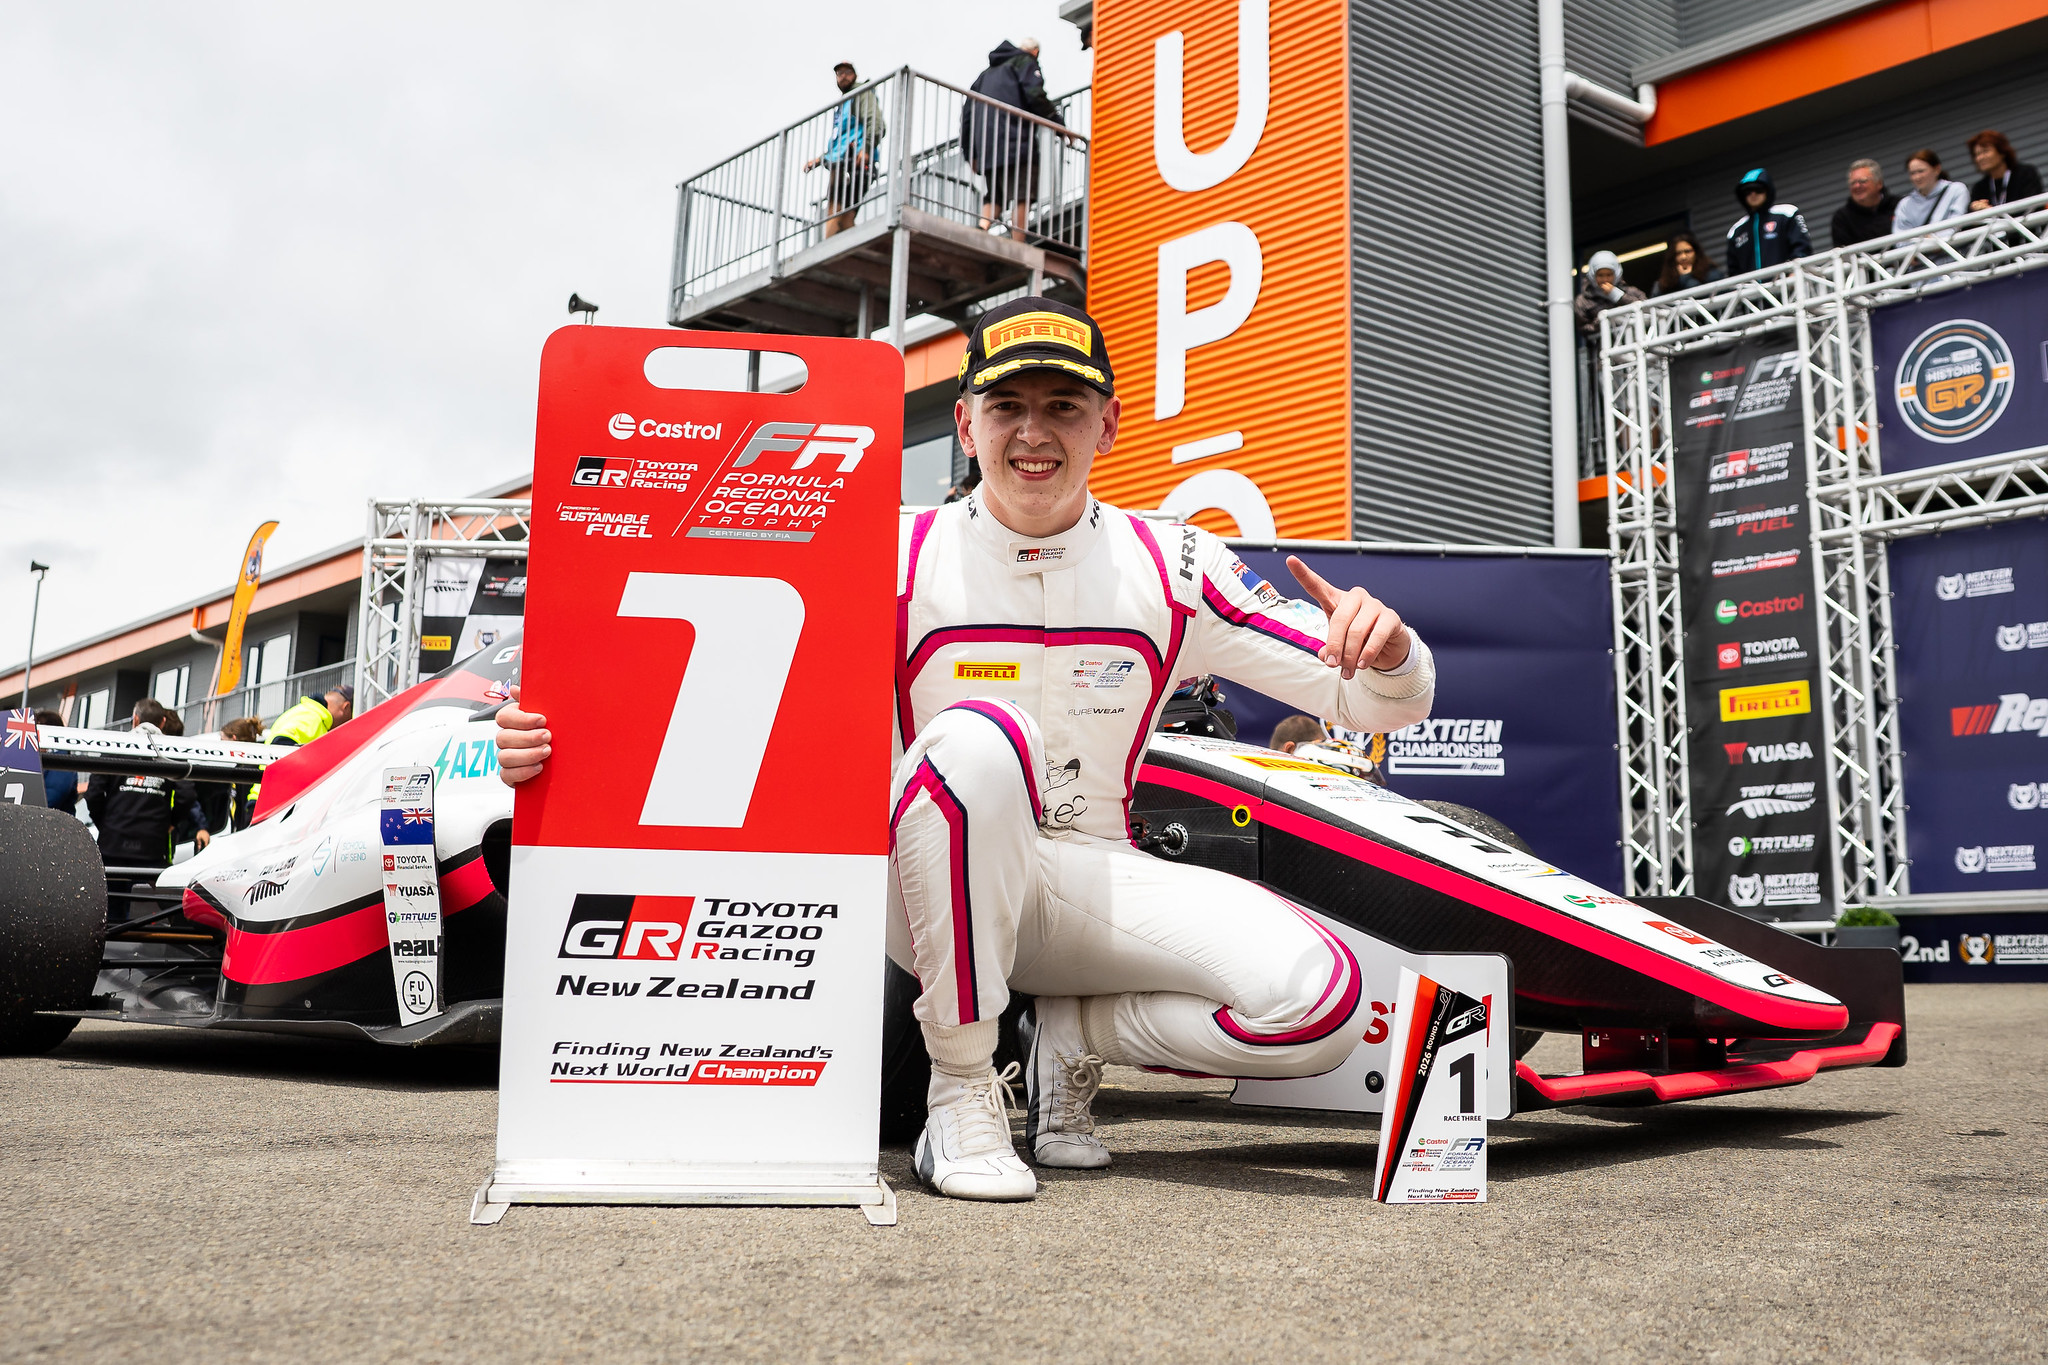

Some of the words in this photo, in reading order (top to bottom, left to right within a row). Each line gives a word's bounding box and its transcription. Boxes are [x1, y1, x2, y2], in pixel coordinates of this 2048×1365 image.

[989, 318, 1087, 350] PIRELLI
[1925, 361, 1983, 383] HISTORIC
[638, 418, 722, 441] Castrol
[731, 421, 876, 473] FR
[633, 469, 691, 481] GAZOO
[636, 459, 698, 472] TOYOTA
[1709, 459, 1747, 481] GR
[574, 468, 628, 487] GR
[630, 479, 688, 492] Racing
[721, 472, 845, 489] FORMULA
[1708, 481, 1736, 494] New
[1736, 469, 1789, 489] Zealand
[711, 486, 837, 503] REGIONAL
[559, 511, 650, 525] SUSTAINABLE
[704, 500, 828, 518] OCEANIA
[1708, 503, 1800, 529] SUSTAINABLE
[585, 523, 653, 539] FUEL
[698, 515, 823, 529] TROPHY
[1737, 516, 1795, 537] FUEL
[708, 530, 759, 539] CERTIFIED
[760, 531, 774, 539] BY
[775, 532, 791, 540] FIA
[1017, 553, 1039, 561] GR
[1179, 528, 1197, 581] HRX
[1260, 587, 1277, 604] GR
[1739, 593, 1804, 618] Castrol
[1742, 637, 1800, 656] TOYOTA
[1105, 661, 1135, 672] FR
[1743, 653, 1777, 665] Financial
[1777, 650, 1808, 661] Services
[957, 663, 1017, 679] PIRELLI
[616, 571, 806, 829] 1
[1729, 689, 1799, 713] PIRELLI
[1067, 707, 1126, 716] PUREWEAR
[1388, 718, 1504, 743] NEXTGEN
[47, 735, 140, 750] TOYOTA
[146, 743, 224, 757] GAZOO
[1388, 741, 1503, 758] CHAMPIONSHIP
[1747, 742, 1814, 764] YUASA
[408, 774, 431, 786] FR
[1739, 784, 1775, 799] TONY
[1775, 781, 1815, 796] QUINN
[342, 841, 367, 851] SCHOOL
[1750, 834, 1815, 850] TATUUS
[340, 853, 349, 862] OF
[350, 851, 367, 862] SEND
[396, 855, 427, 864] TOYOTA
[1764, 872, 1820, 887] NEXTGEN
[398, 885, 435, 897] YUASA
[400, 912, 437, 921] TATUUS
[703, 898, 839, 920] TOYOTA
[563, 920, 684, 959] GR
[696, 920, 824, 941] GAZOO
[690, 941, 816, 968] Racing
[1901, 935, 1951, 962] 2nd
[409, 981, 425, 992] FU
[555, 974, 642, 997] New
[645, 976, 816, 1001] Zealand
[1362, 1001, 1397, 1045] S
[1445, 1004, 1486, 1036] GR
[551, 1041, 652, 1061] Finding
[659, 1043, 713, 1058] New
[718, 1044, 834, 1059] Zealand's
[1418, 1051, 1432, 1077] 2026
[1426, 1024, 1439, 1050] ROUND
[550, 1061, 609, 1077] Next
[616, 1063, 690, 1078] World
[697, 1063, 818, 1084] Champion
[1450, 1053, 1475, 1114] 1
[1450, 1137, 1486, 1151] FR
